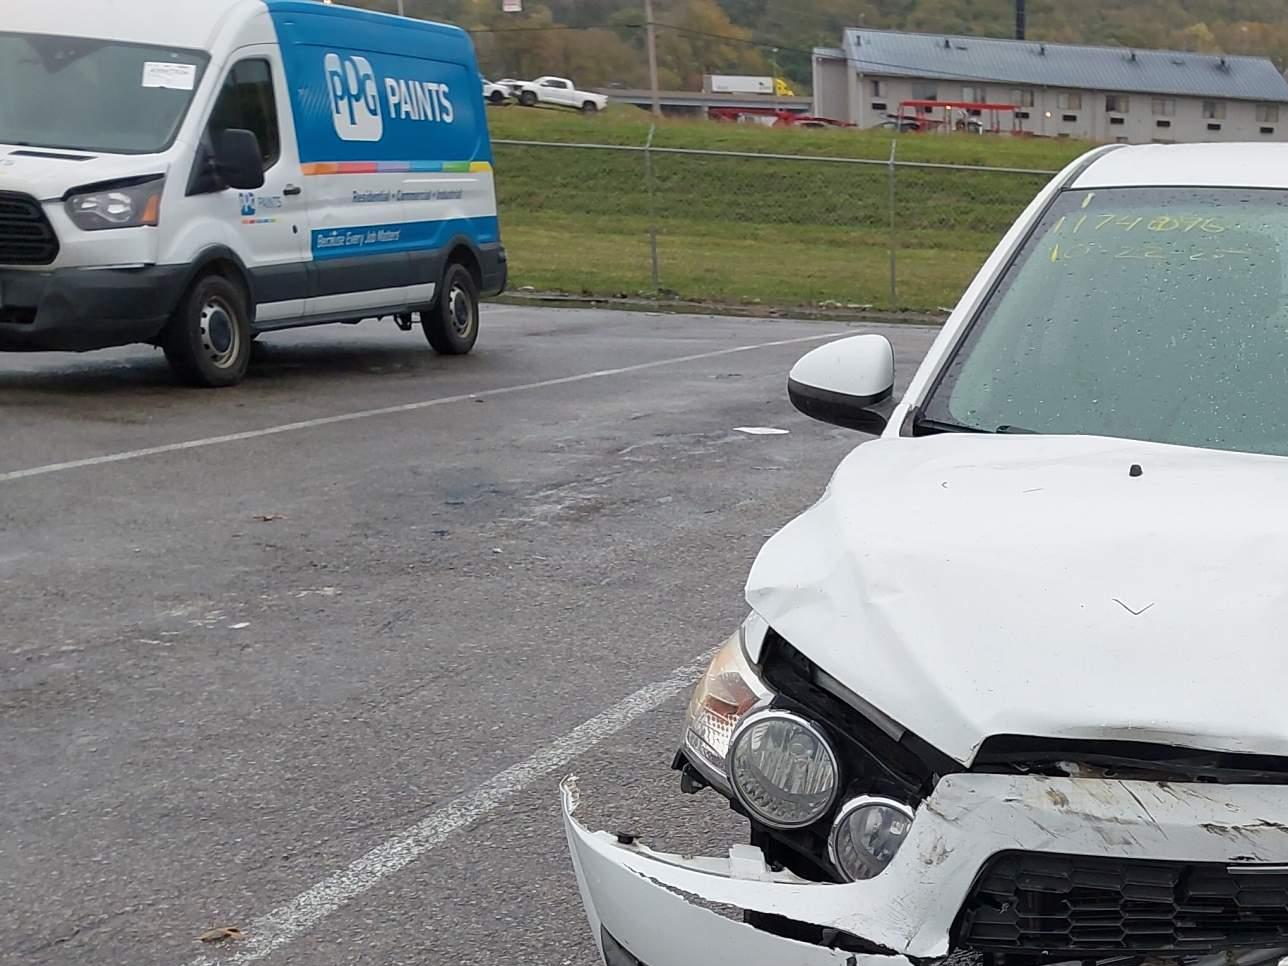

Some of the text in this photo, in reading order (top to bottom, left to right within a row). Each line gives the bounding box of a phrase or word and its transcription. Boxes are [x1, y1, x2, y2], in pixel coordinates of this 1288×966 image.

[325, 54, 454, 130] PPG PAINTS
[352, 188, 389, 203] Residential
